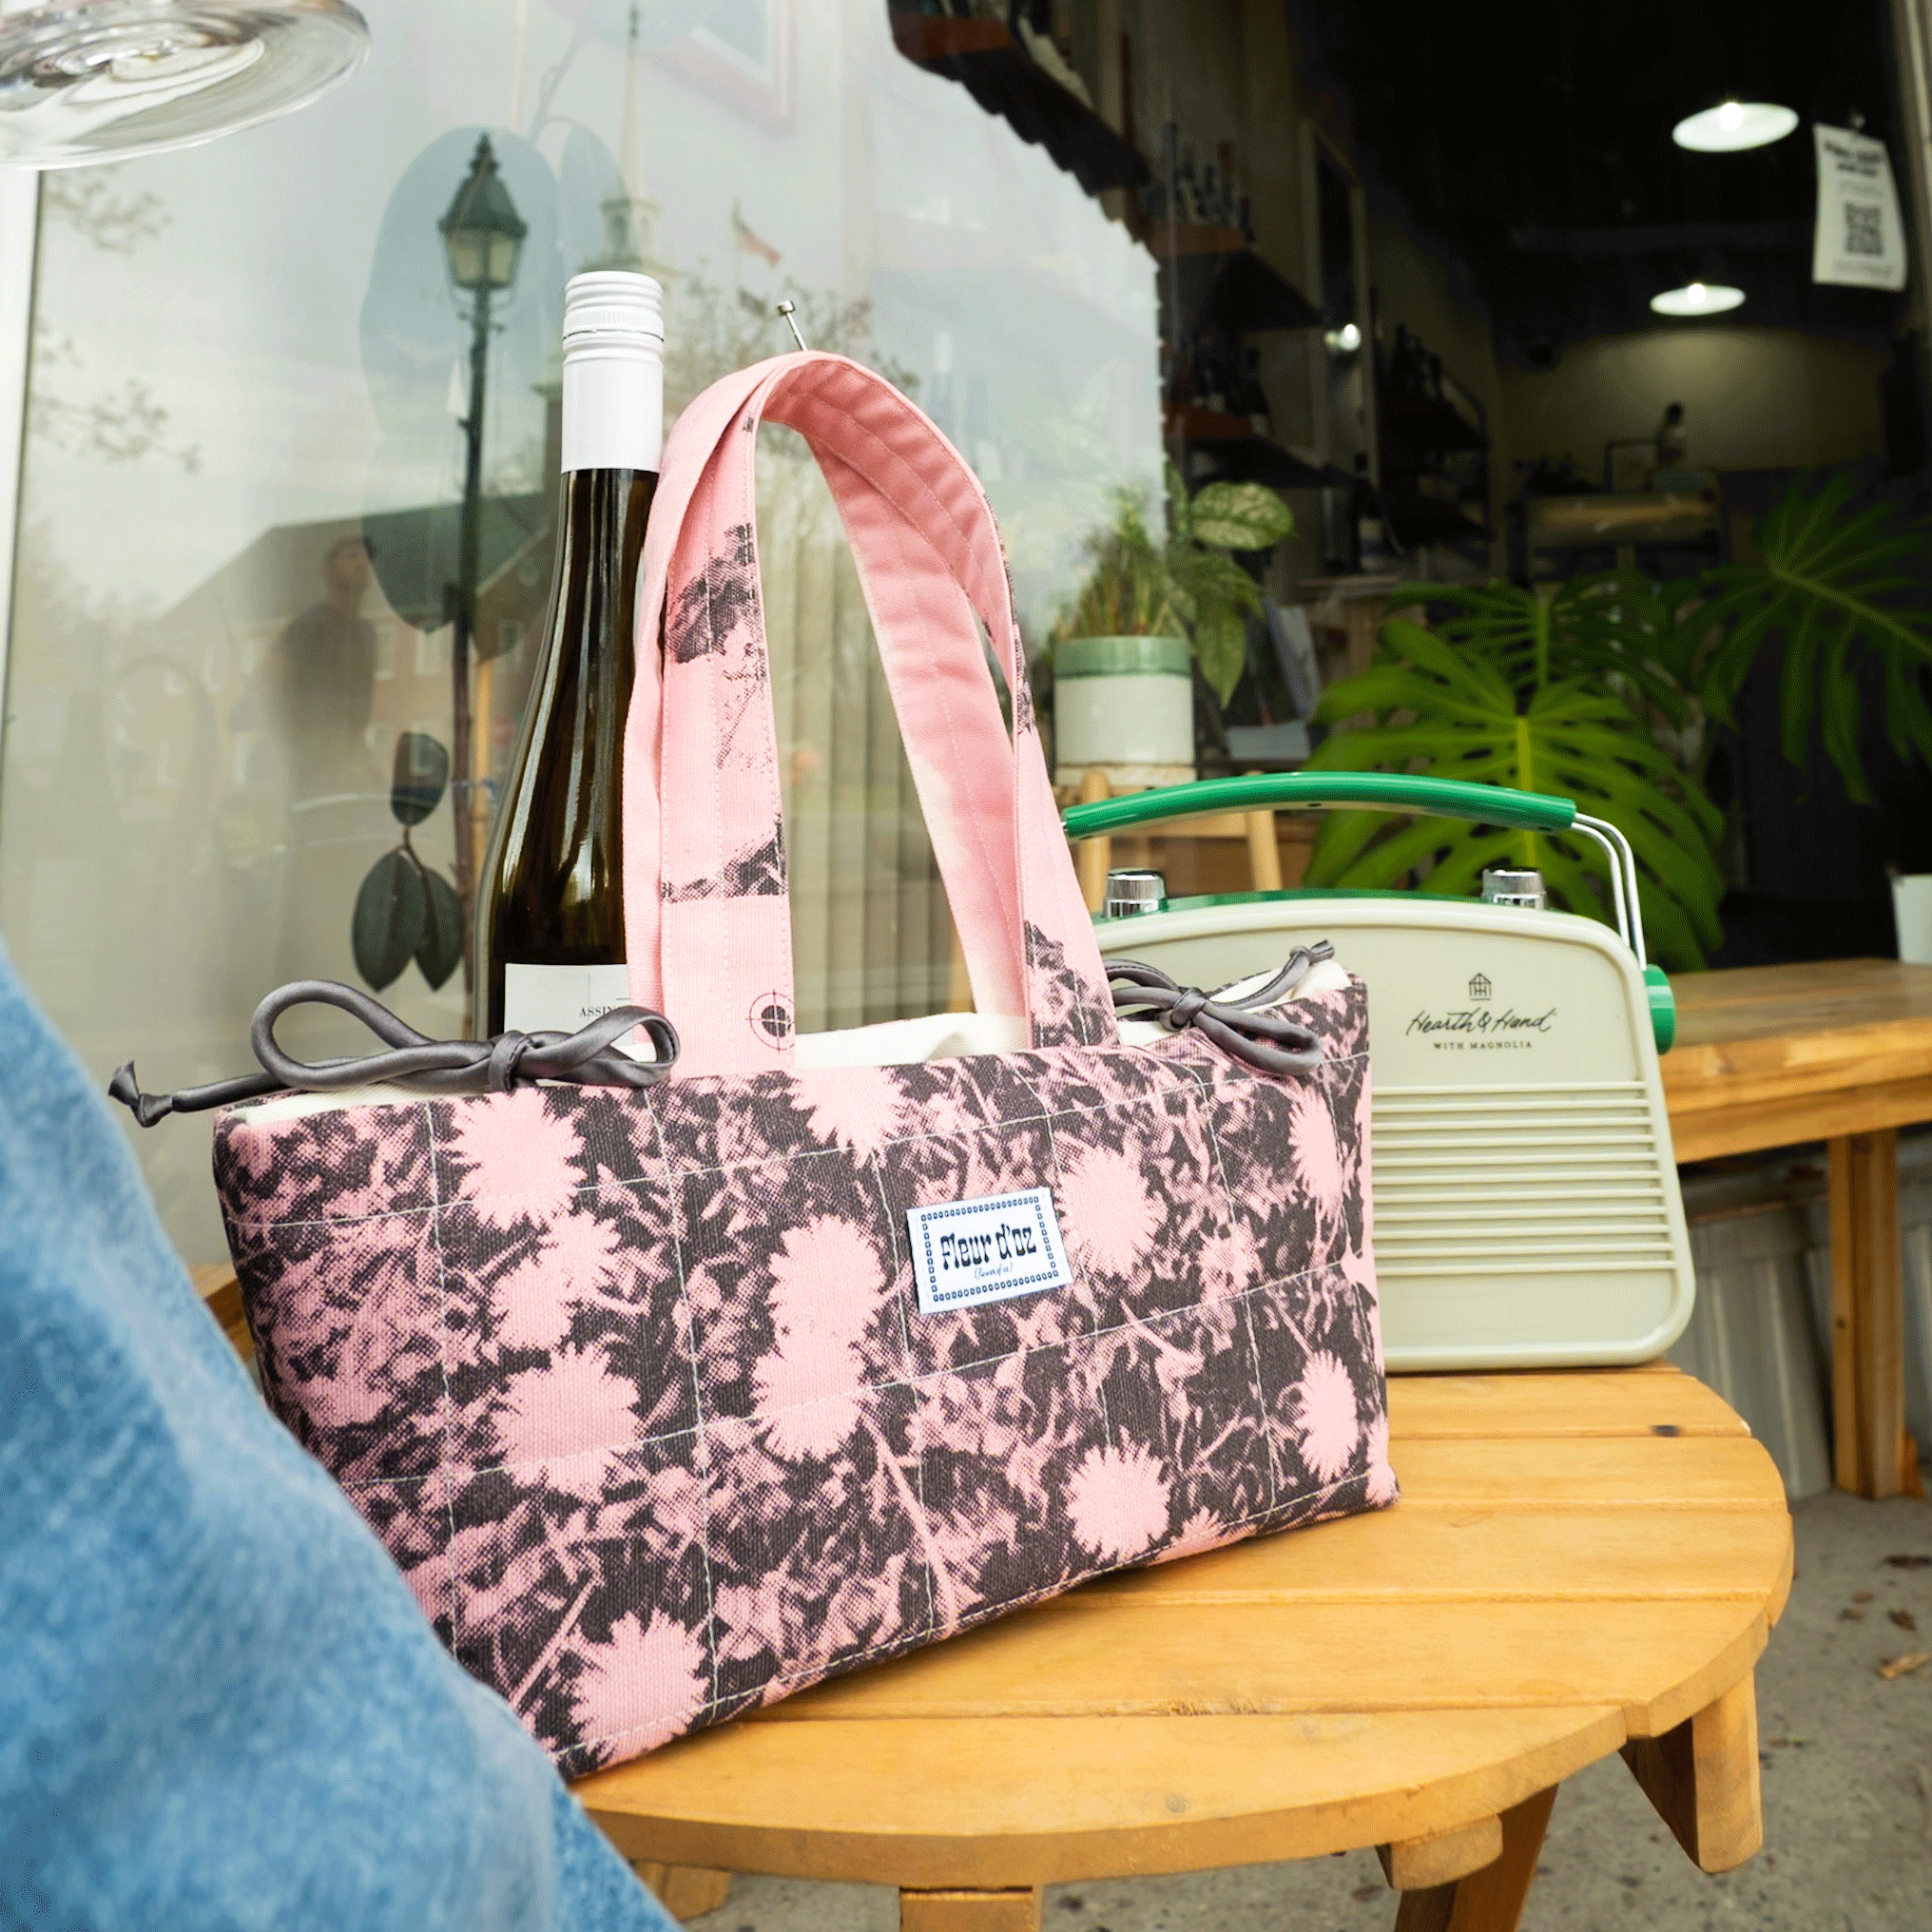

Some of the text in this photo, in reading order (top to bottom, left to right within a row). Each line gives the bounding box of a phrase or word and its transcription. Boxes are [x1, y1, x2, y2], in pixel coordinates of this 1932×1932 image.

[1406, 1007, 1556, 1035] Hearth & Hand
[1470, 1041, 1533, 1050] MAGNOLIA
[940, 1232, 992, 1270] Fleur
